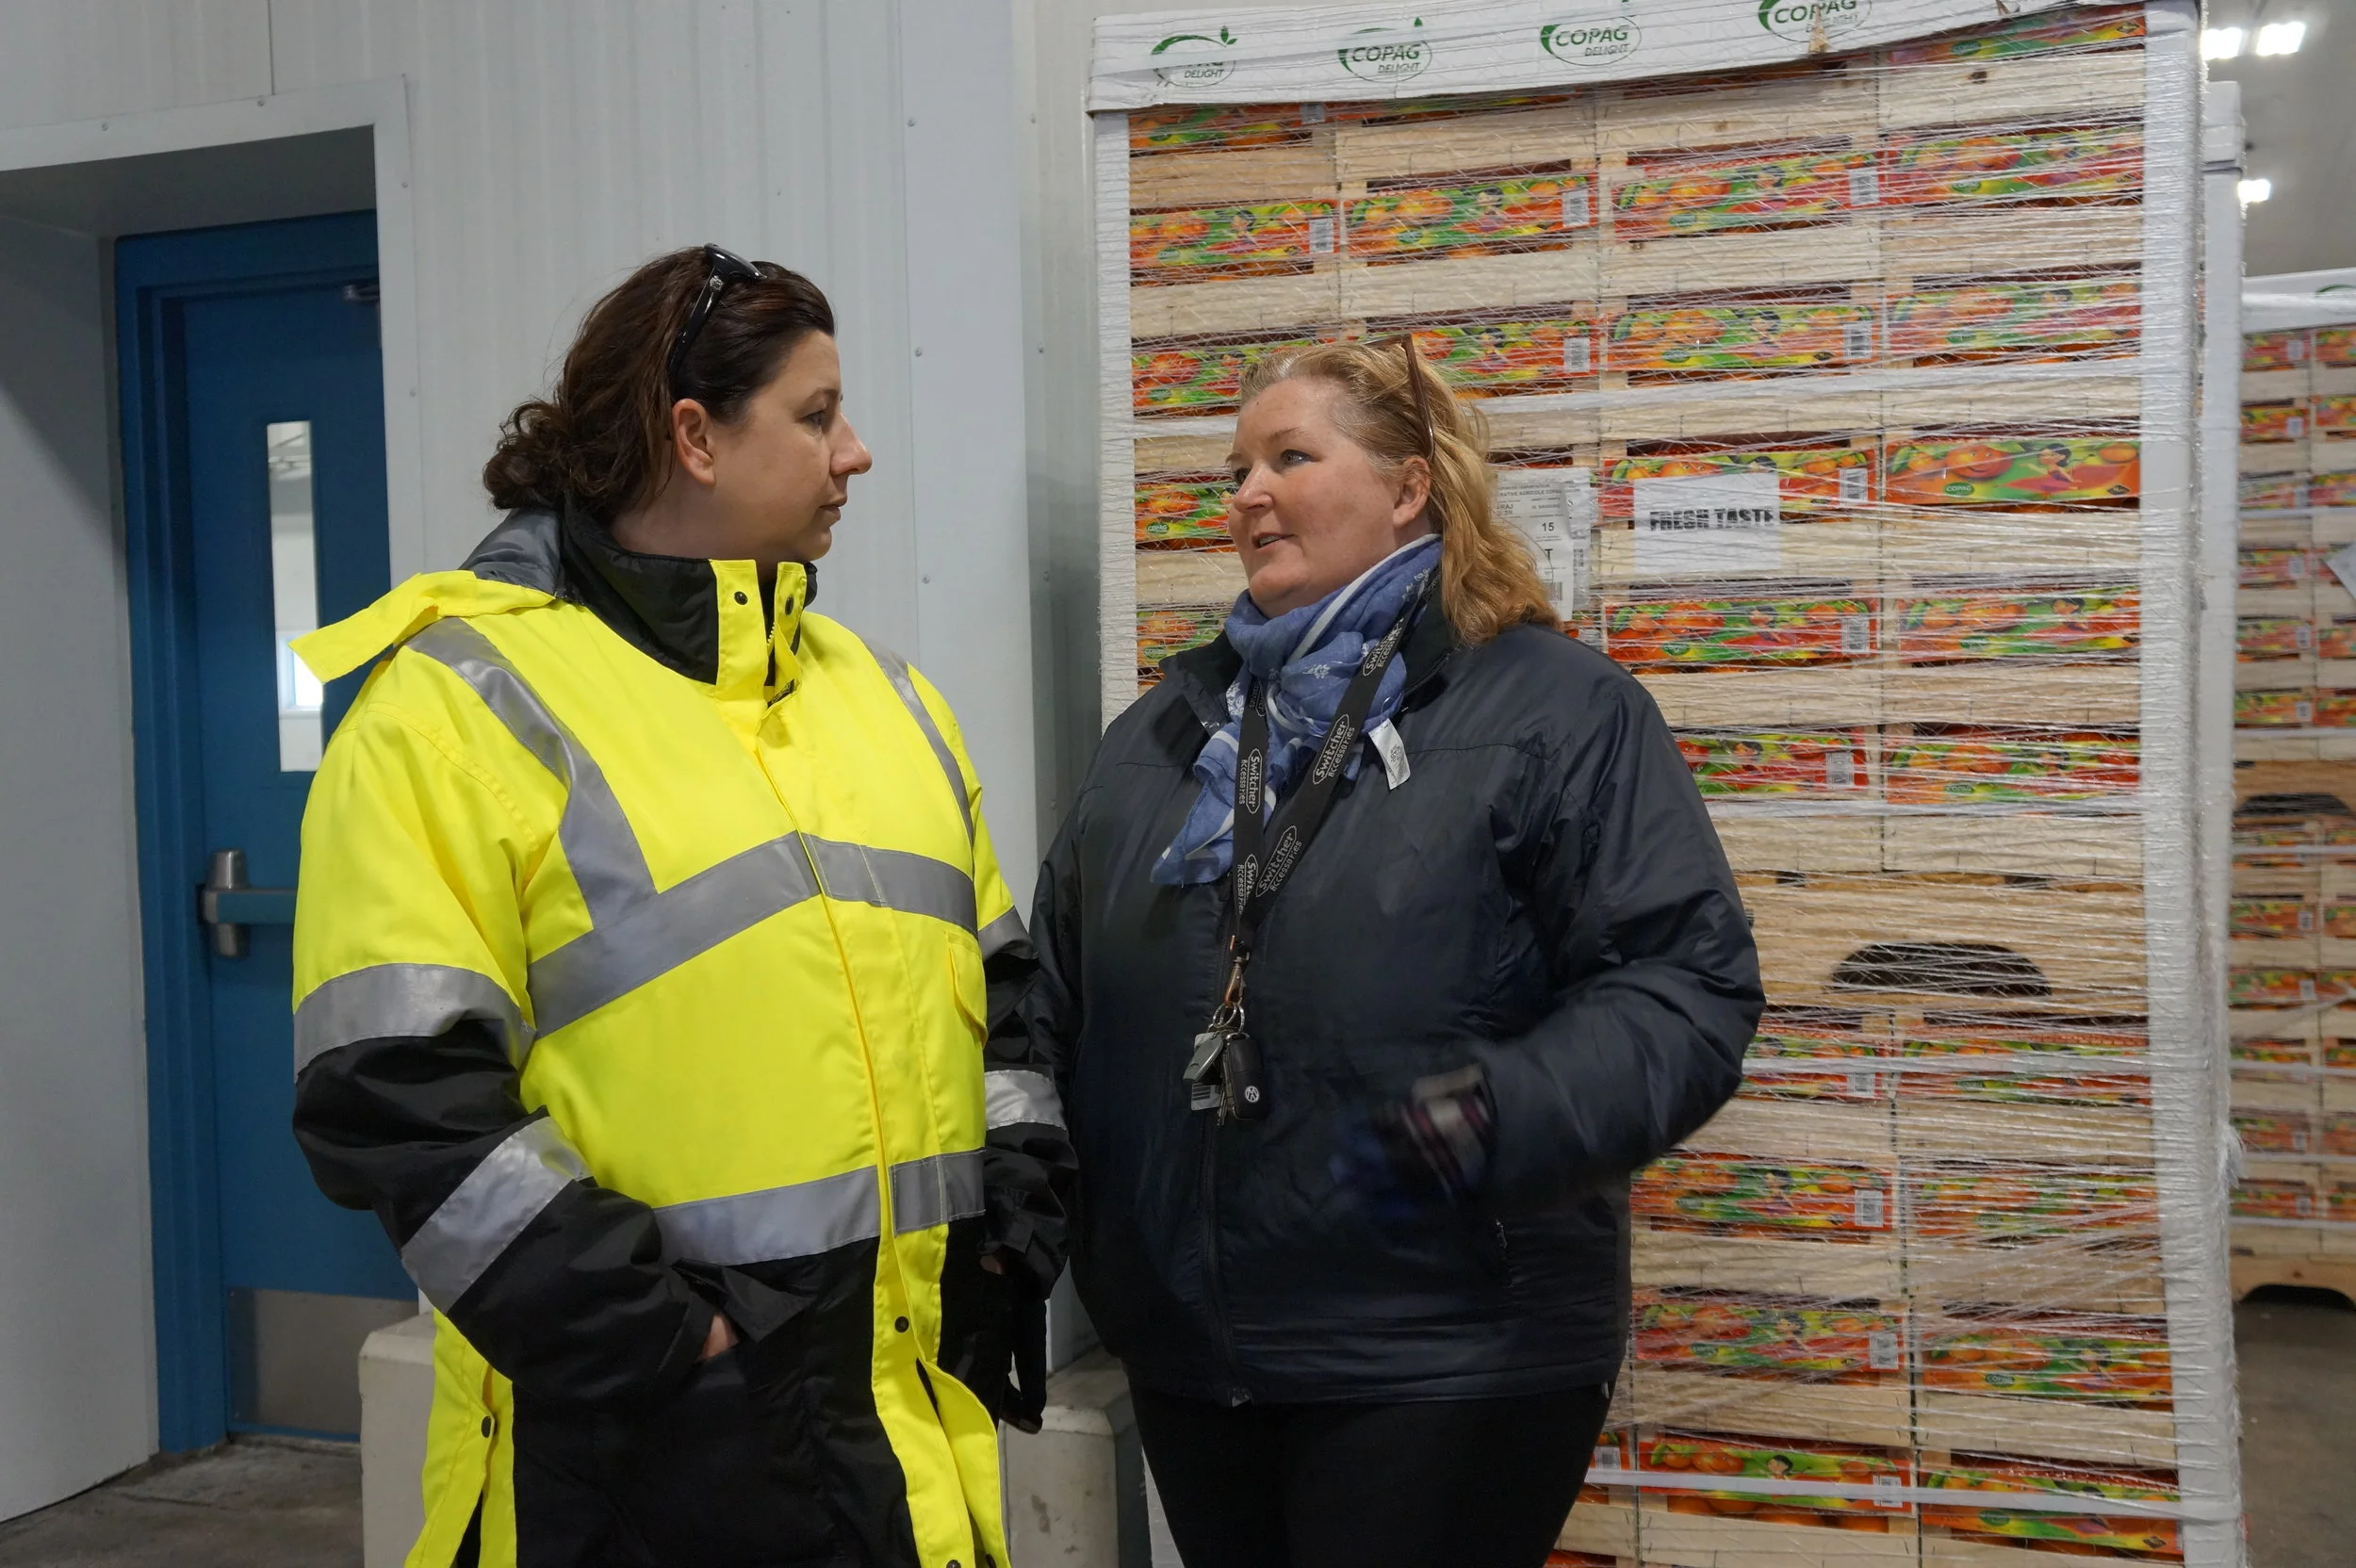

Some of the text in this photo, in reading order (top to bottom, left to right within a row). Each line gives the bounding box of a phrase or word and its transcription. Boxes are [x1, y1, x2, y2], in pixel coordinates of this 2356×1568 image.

[1351, 43, 1421, 62] COPAG
[1556, 24, 1629, 47] COPAG
[1584, 42, 1630, 57] DELIGHT
[1184, 68, 1225, 78] DELIGHT
[1377, 62, 1421, 74] DELIGHT
[1542, 521, 1555, 532] 15
[1316, 721, 1347, 778] Switcher
[1328, 727, 1356, 777] Accessories
[1238, 759, 1249, 805] Accessories
[1248, 756, 1260, 808] Switcher
[1259, 832, 1294, 890] Switcher
[1269, 841, 1302, 892] Accessories
